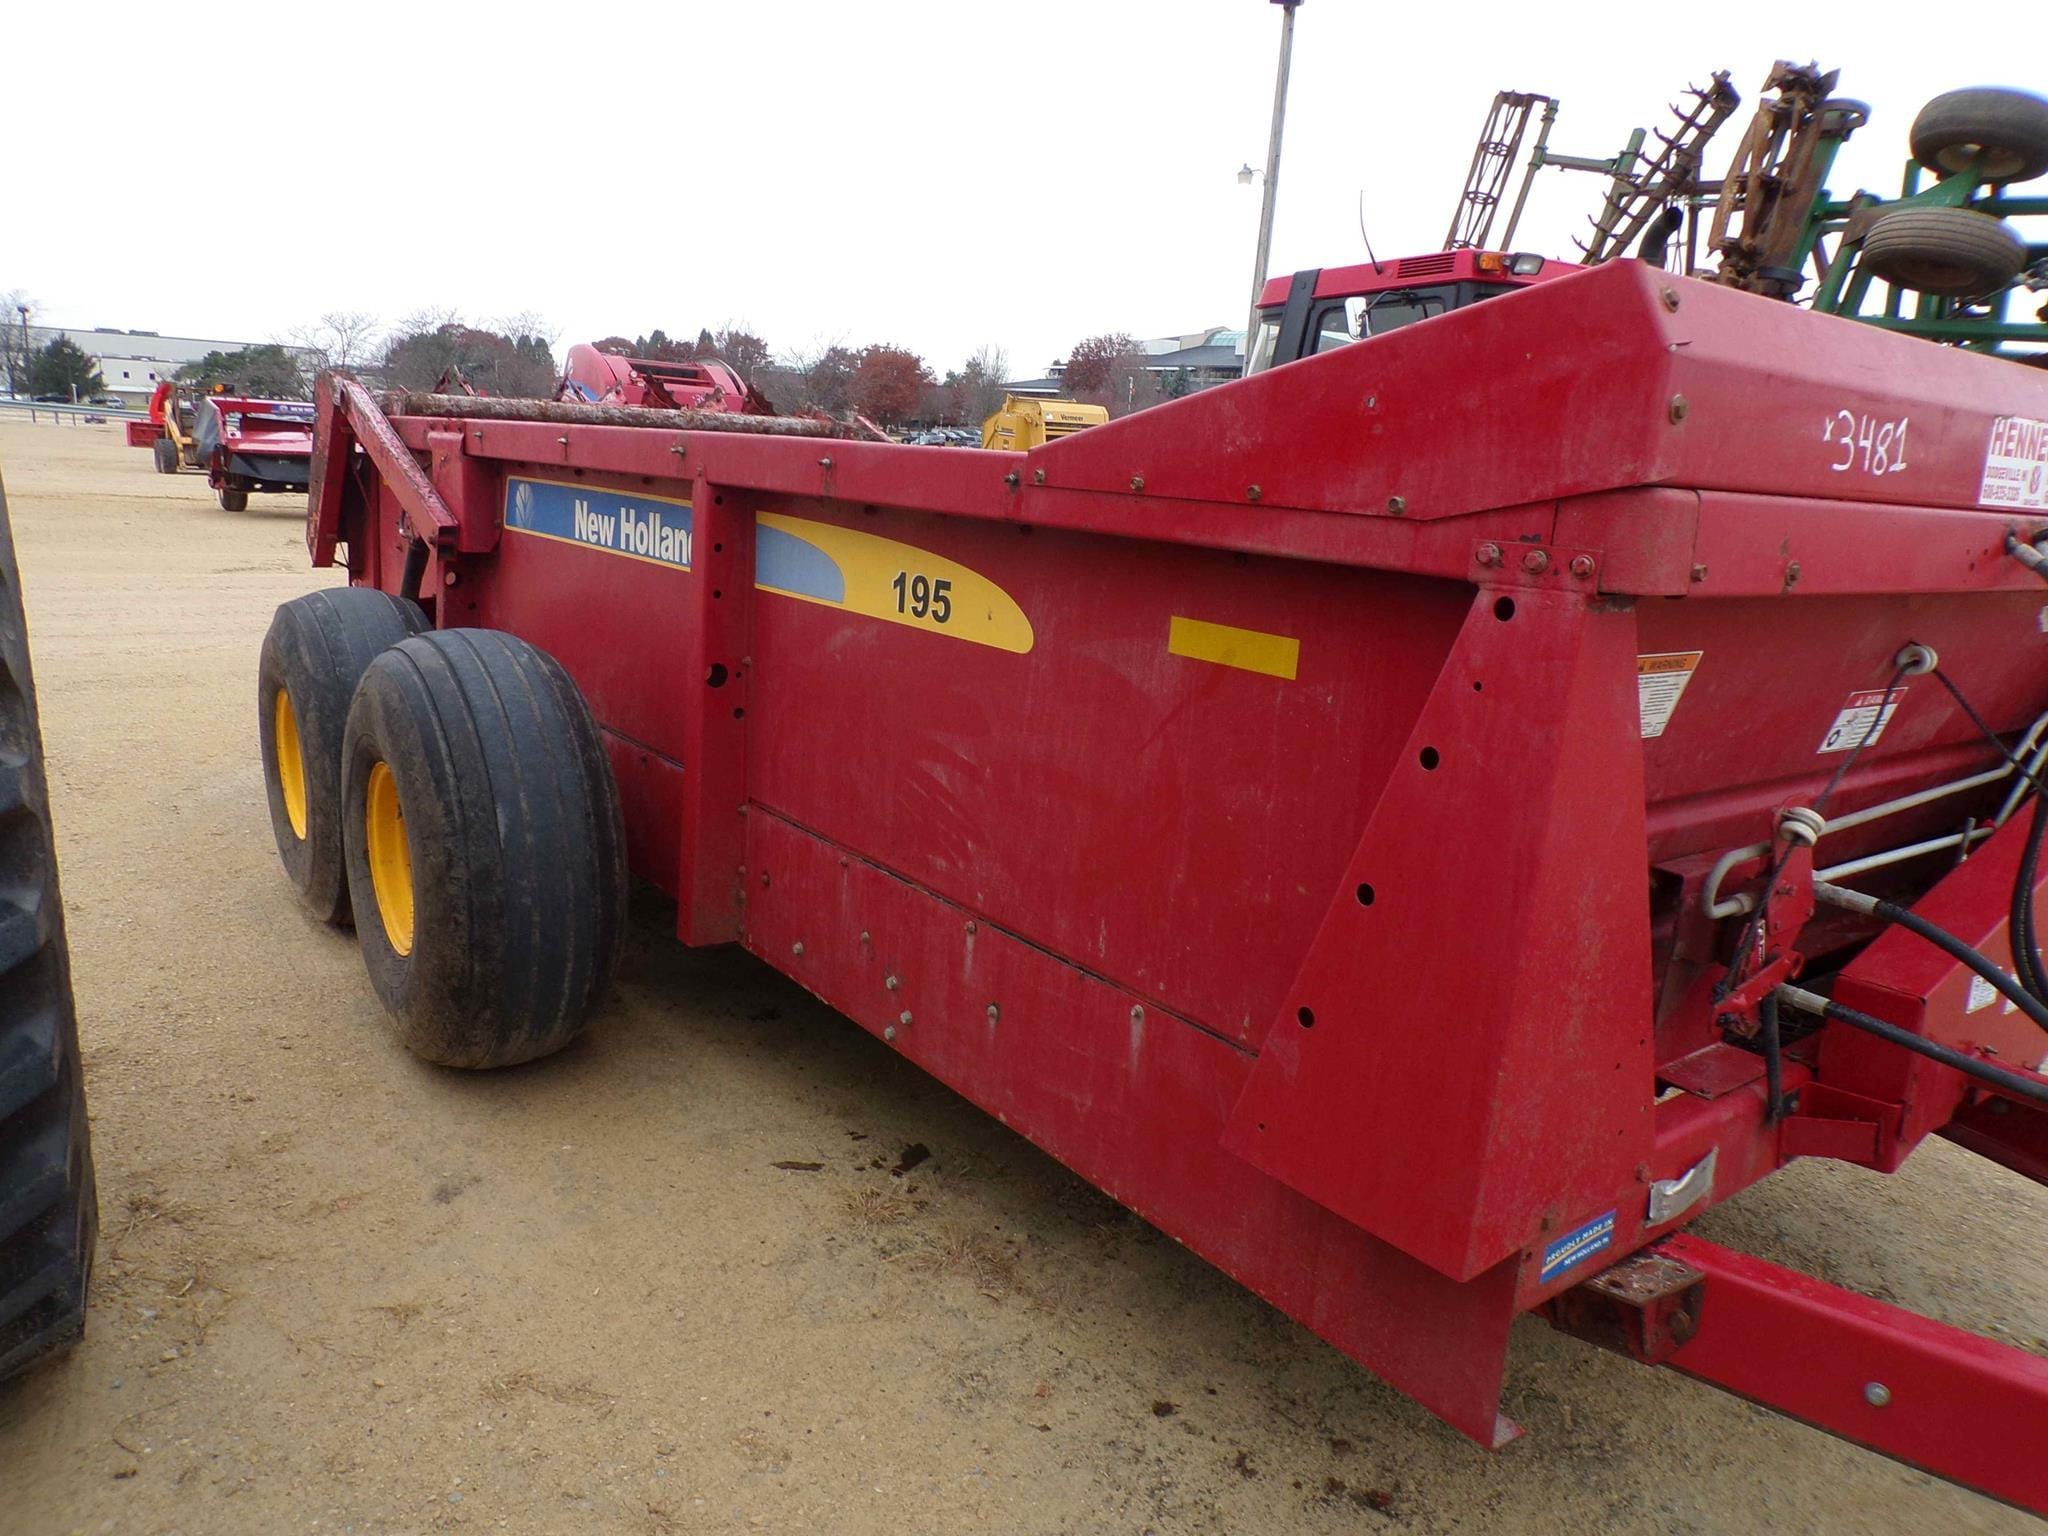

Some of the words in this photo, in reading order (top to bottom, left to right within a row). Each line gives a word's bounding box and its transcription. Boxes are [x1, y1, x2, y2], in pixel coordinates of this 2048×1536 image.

[1061, 414, 1083, 423] Vermeer
[574, 499, 615, 547] New
[621, 507, 692, 563] Hollan
[892, 571, 951, 624] 195
